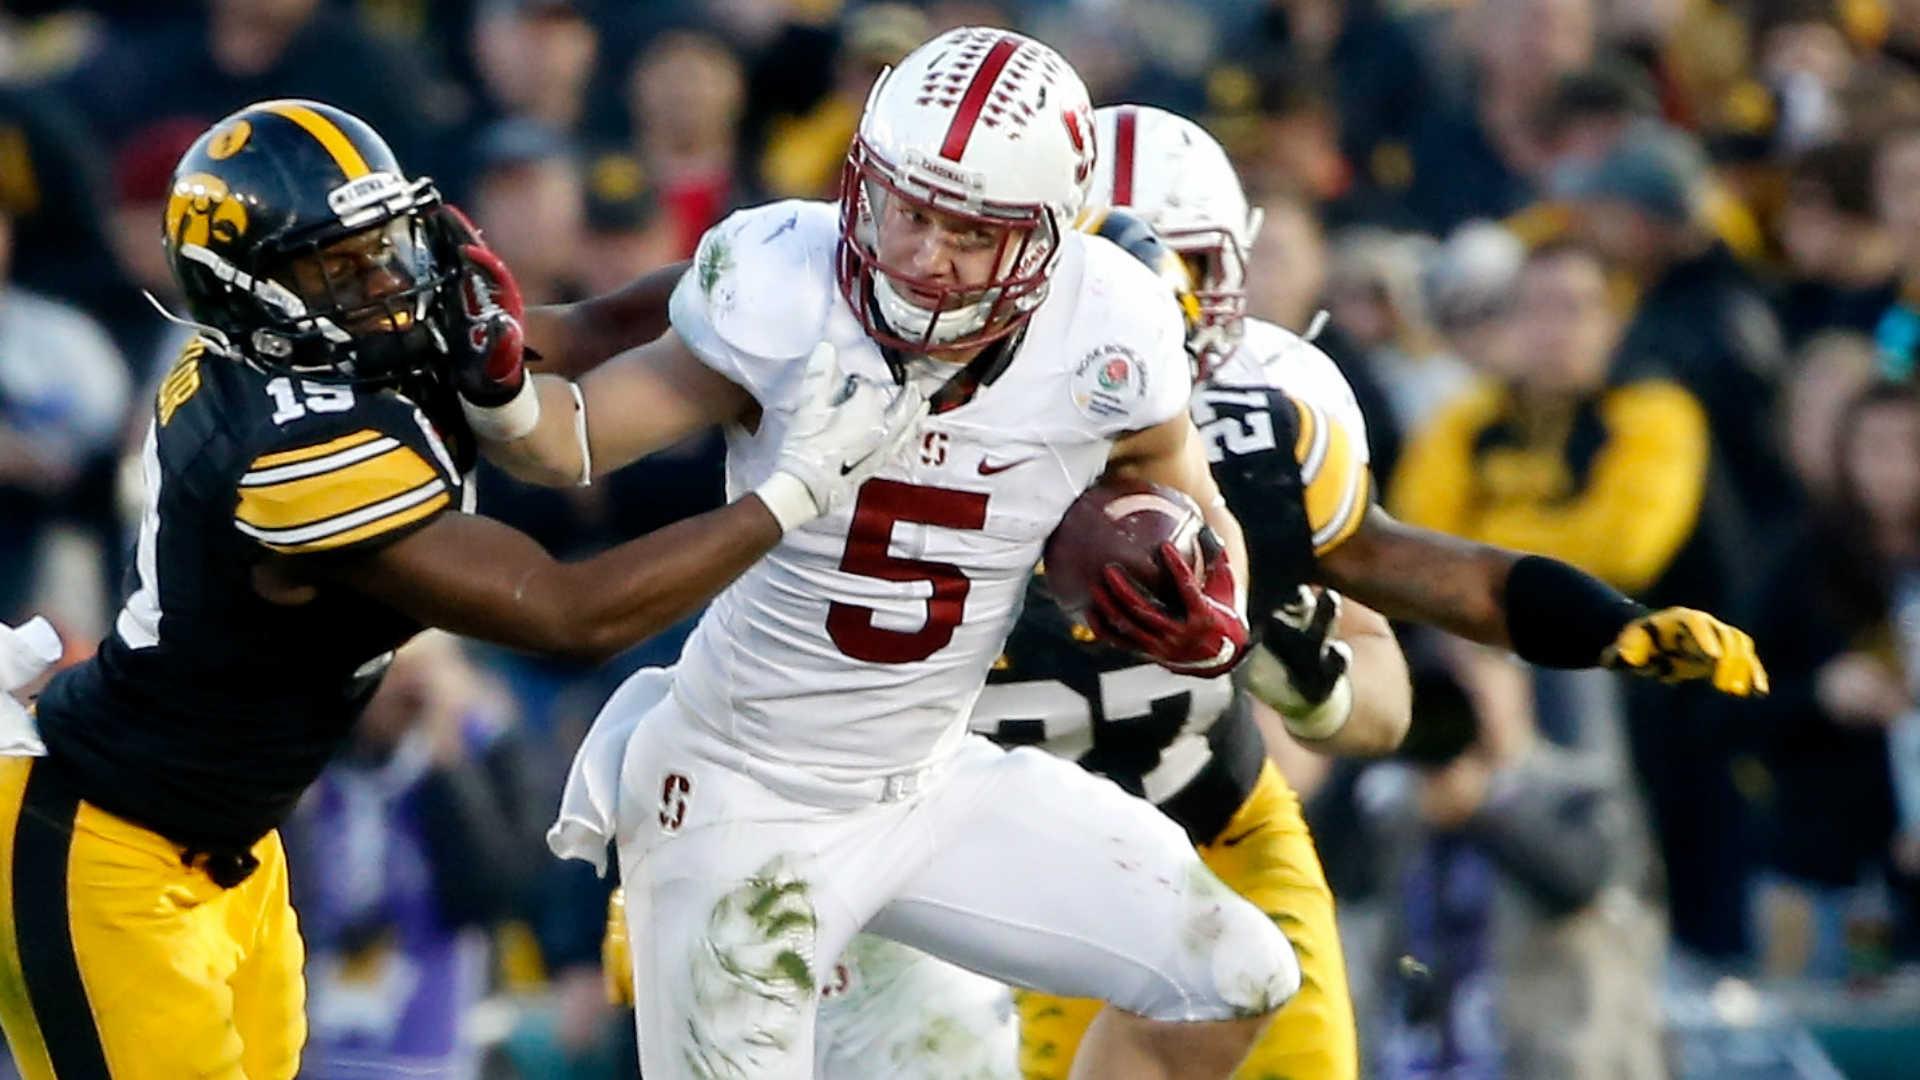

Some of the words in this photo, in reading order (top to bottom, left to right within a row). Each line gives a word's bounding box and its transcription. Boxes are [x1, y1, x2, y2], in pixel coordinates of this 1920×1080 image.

[265, 376, 355, 425] 15
[1190, 385, 1276, 464] 27
[825, 476, 991, 665] 5
